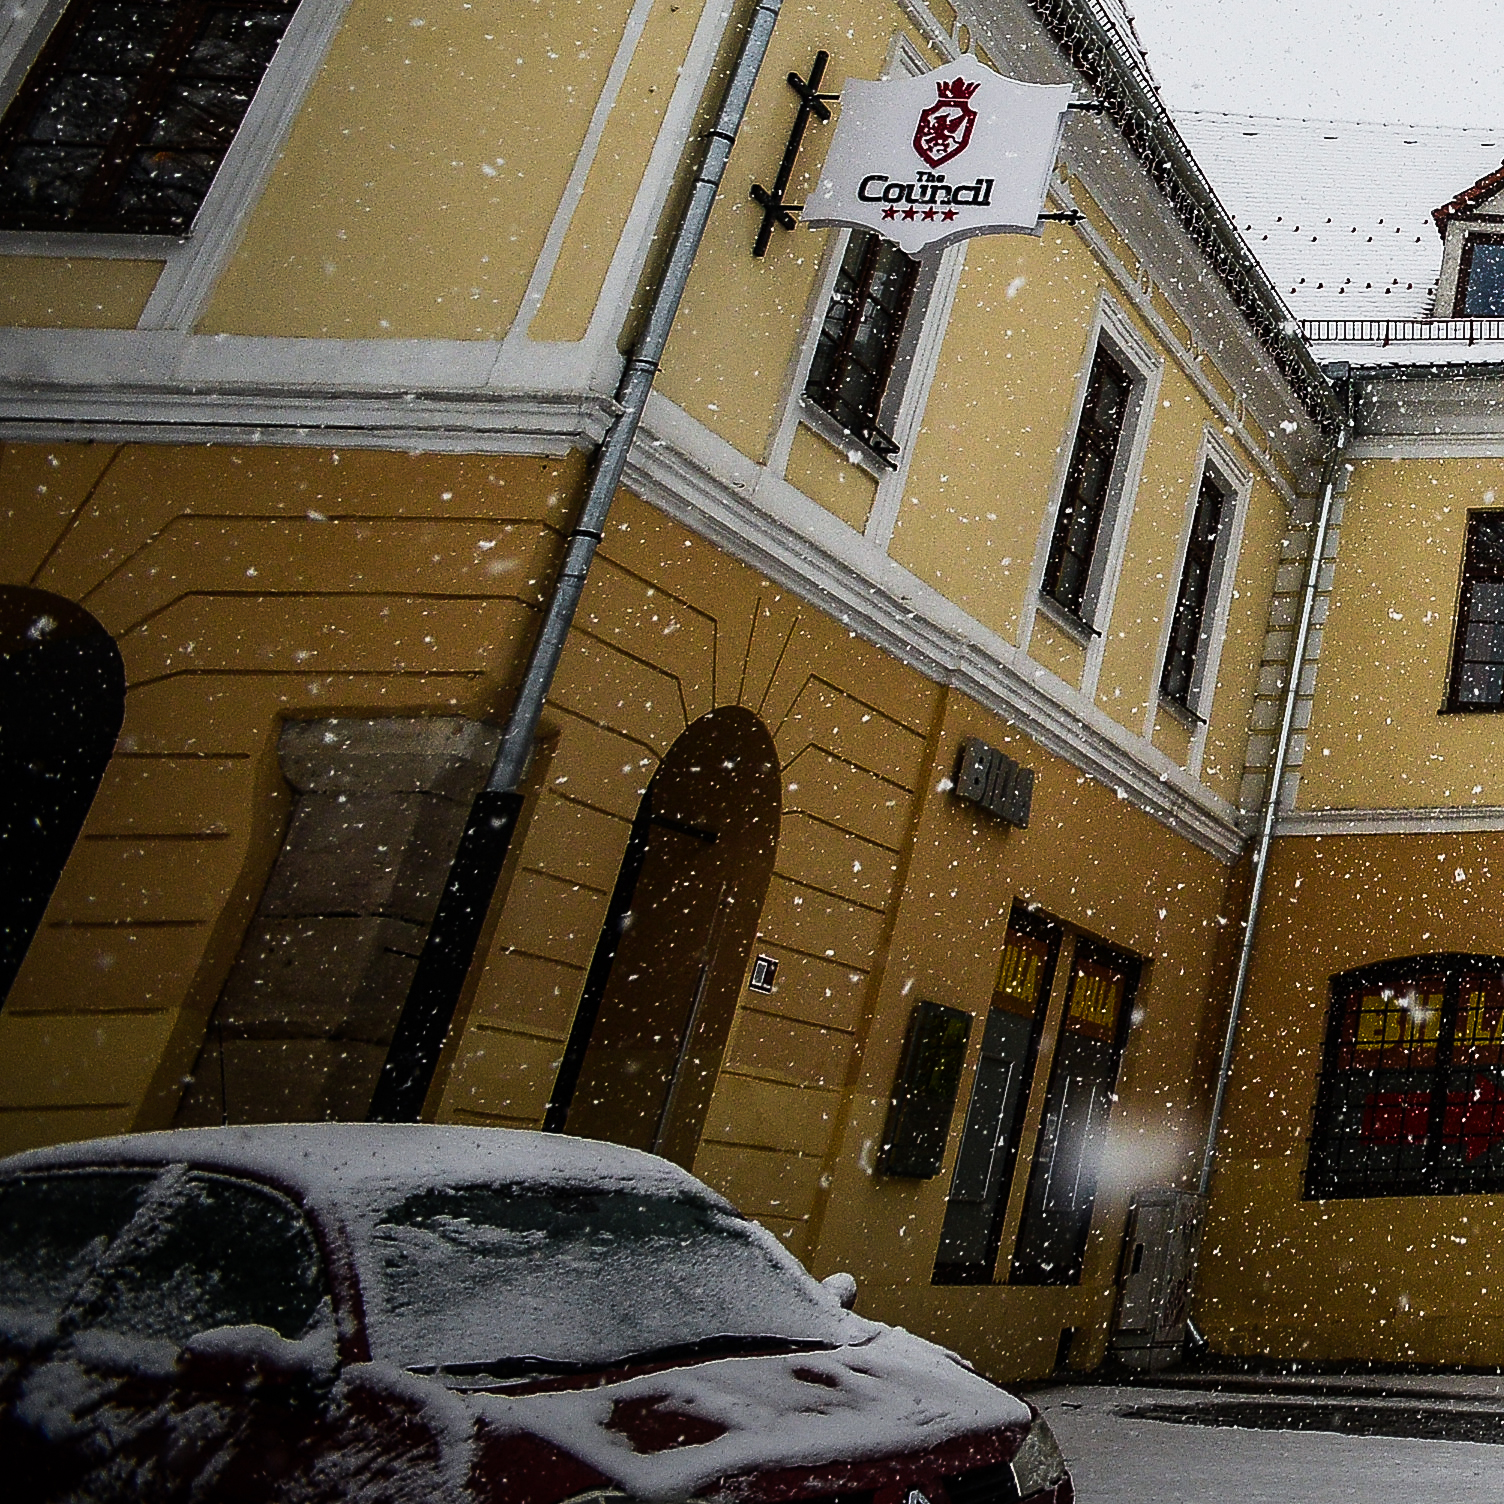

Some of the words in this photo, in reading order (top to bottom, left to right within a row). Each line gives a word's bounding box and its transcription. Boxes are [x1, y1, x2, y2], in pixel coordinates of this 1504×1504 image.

[857, 175, 995, 206] Council
[916, 171, 946, 183] The
[956, 737, 1034, 829] BILLA
